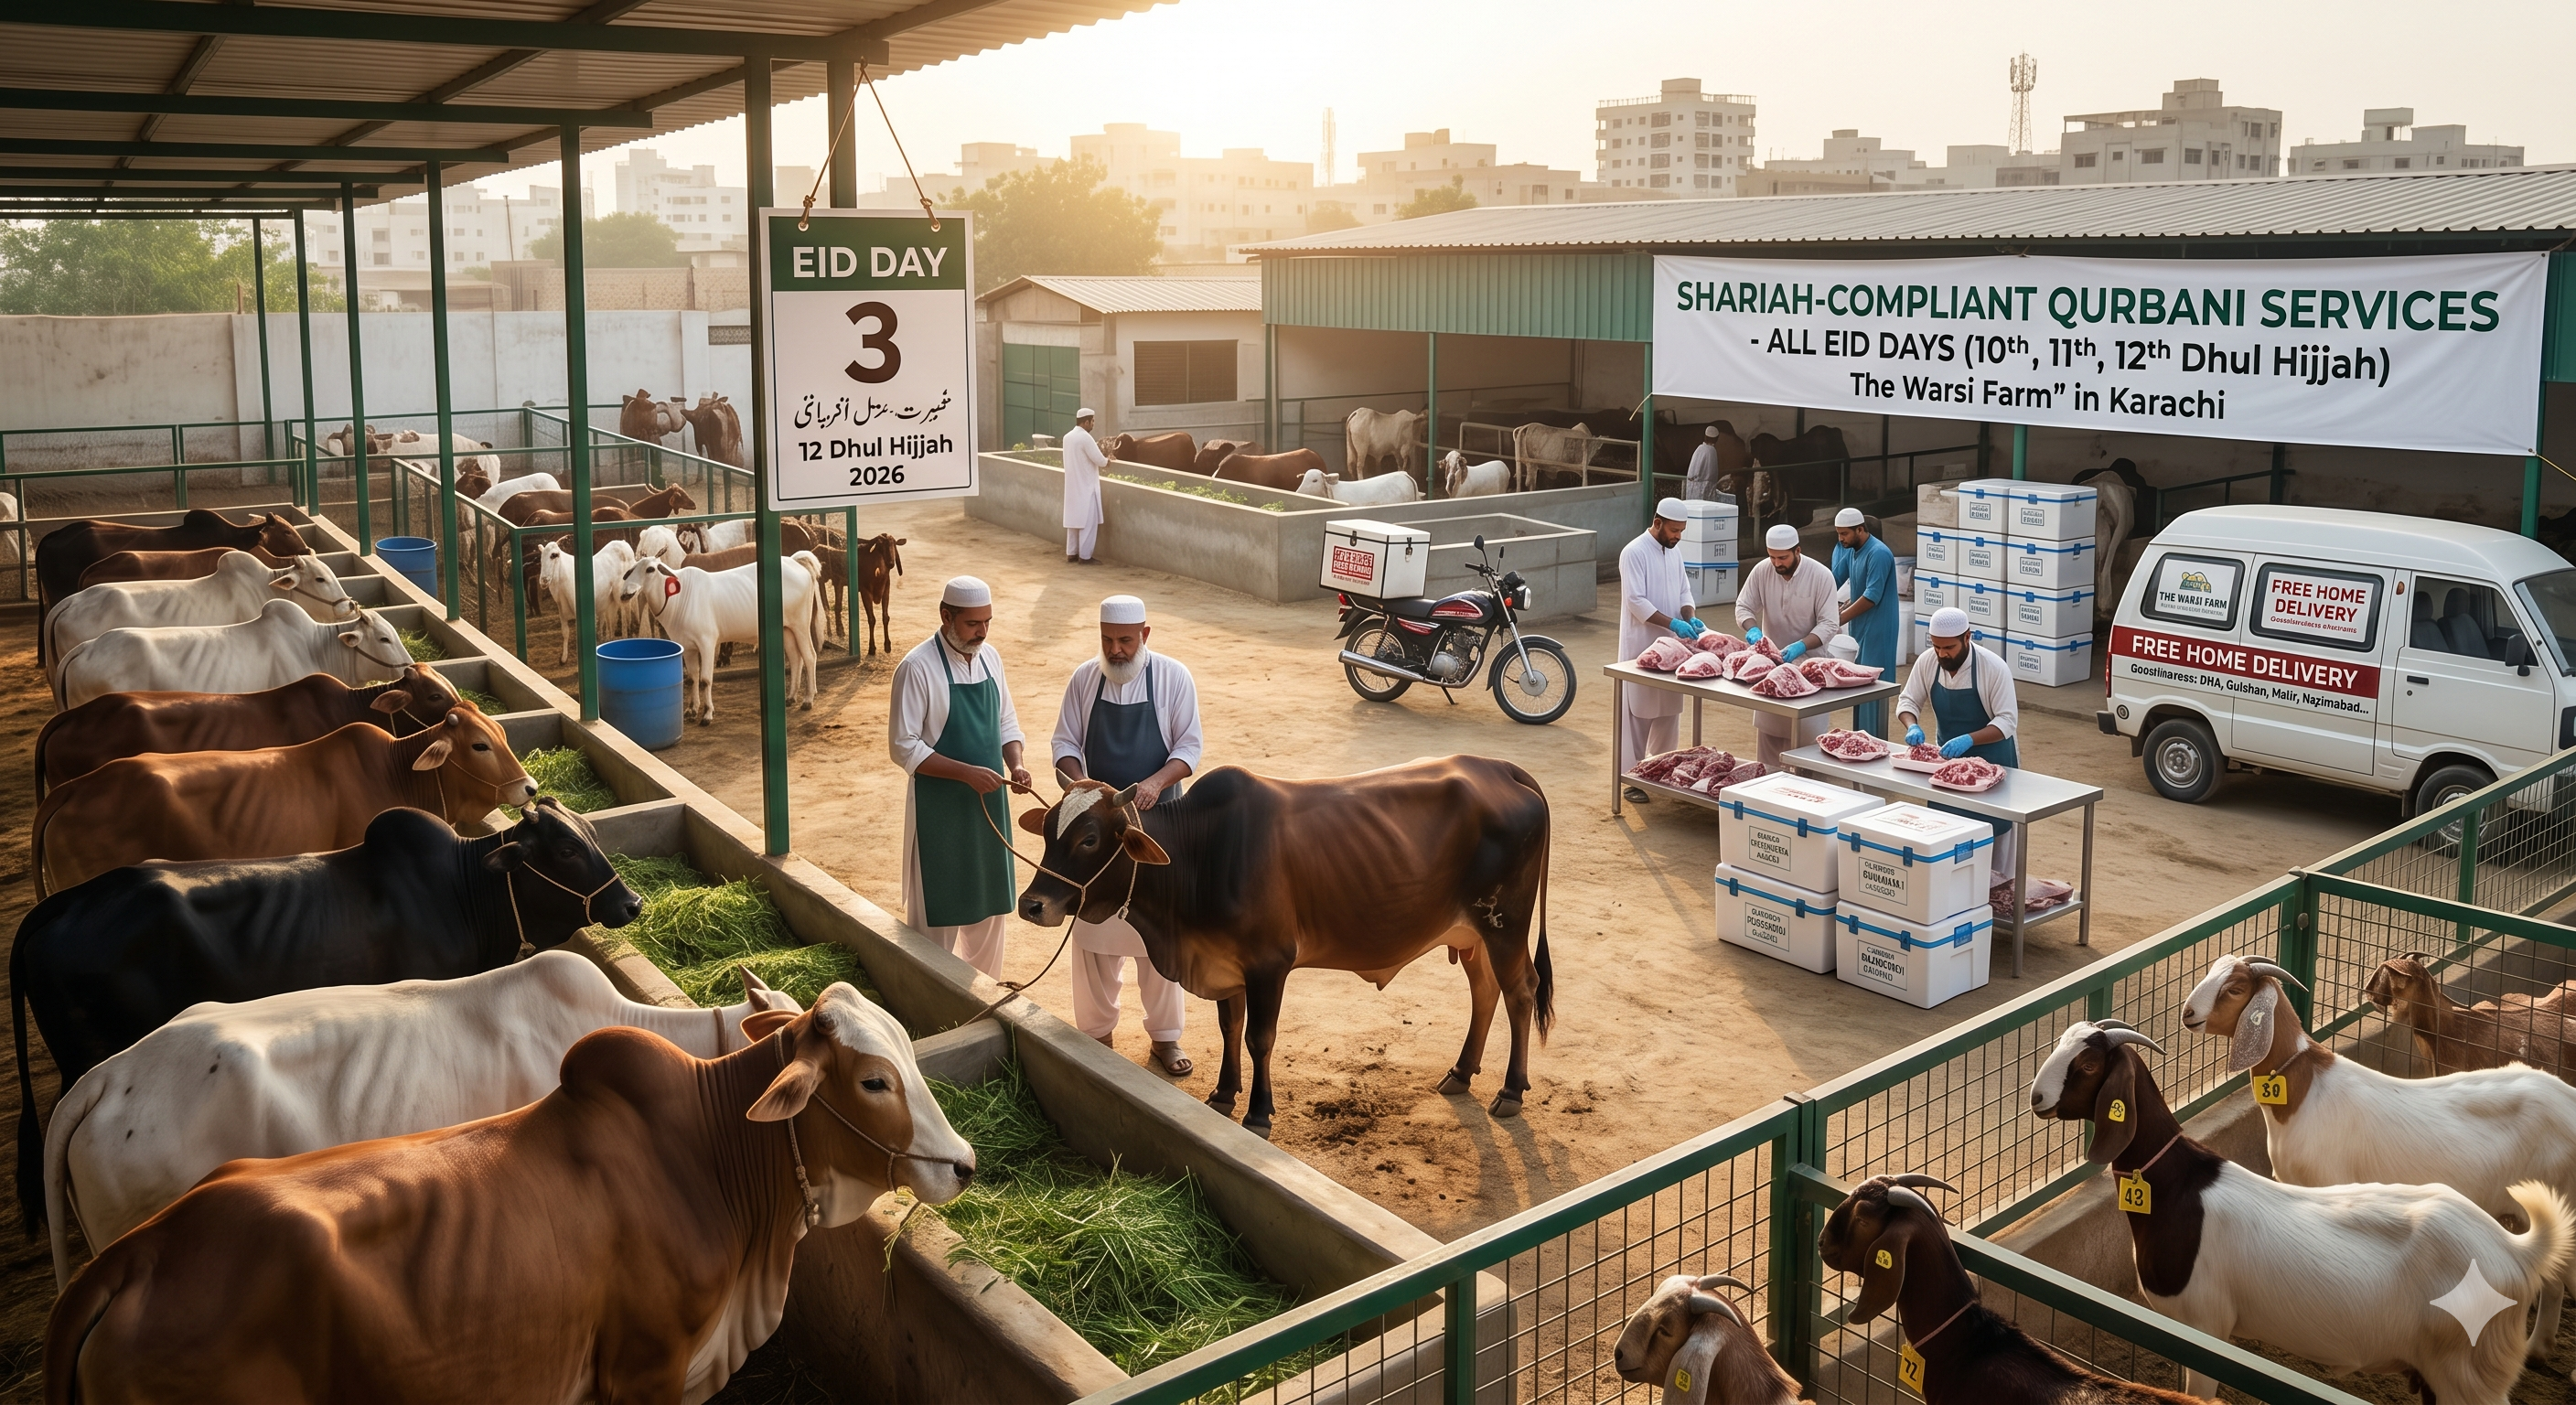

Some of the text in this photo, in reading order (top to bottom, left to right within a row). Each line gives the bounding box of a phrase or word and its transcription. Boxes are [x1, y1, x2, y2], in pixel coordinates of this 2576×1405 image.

[792, 246, 948, 278] EID DAY
[1677, 281, 2500, 333] SHARIAH-COMPLIANT QURBANI SERVICES
[844, 301, 902, 384] 3
[1766, 327, 1817, 356] ALL
[1825, 329, 1870, 358] EID
[1879, 331, 1955, 362] DAYS
[2115, 338, 2171, 370] 12th
[2182, 342, 2261, 375] Dhul
[2273, 343, 2390, 388] Hijjah)
[1850, 371, 1895, 399] The
[1903, 375, 1974, 404] Warsi
[2074, 381, 2099, 412] in
[2109, 386, 2225, 420] Karachi
[798, 434, 953, 462] 12 Dhul Hijjah
[849, 465, 905, 487] 2026
[2159, 591, 2176, 602] THE
[2178, 594, 2203, 606] WARSI
[2205, 597, 2227, 609] FARM
[2271, 579, 2367, 605] FREE HOME
[2274, 598, 2358, 623] DELIVERY
[2132, 635, 2358, 689] FREE HOME DELIVERY
[2200, 675, 2224, 691] DHA,
[2227, 680, 2270, 700] Gulshan,
[2272, 687, 2300, 704] Malir,
[2125, 1187, 2143, 1207] 43
